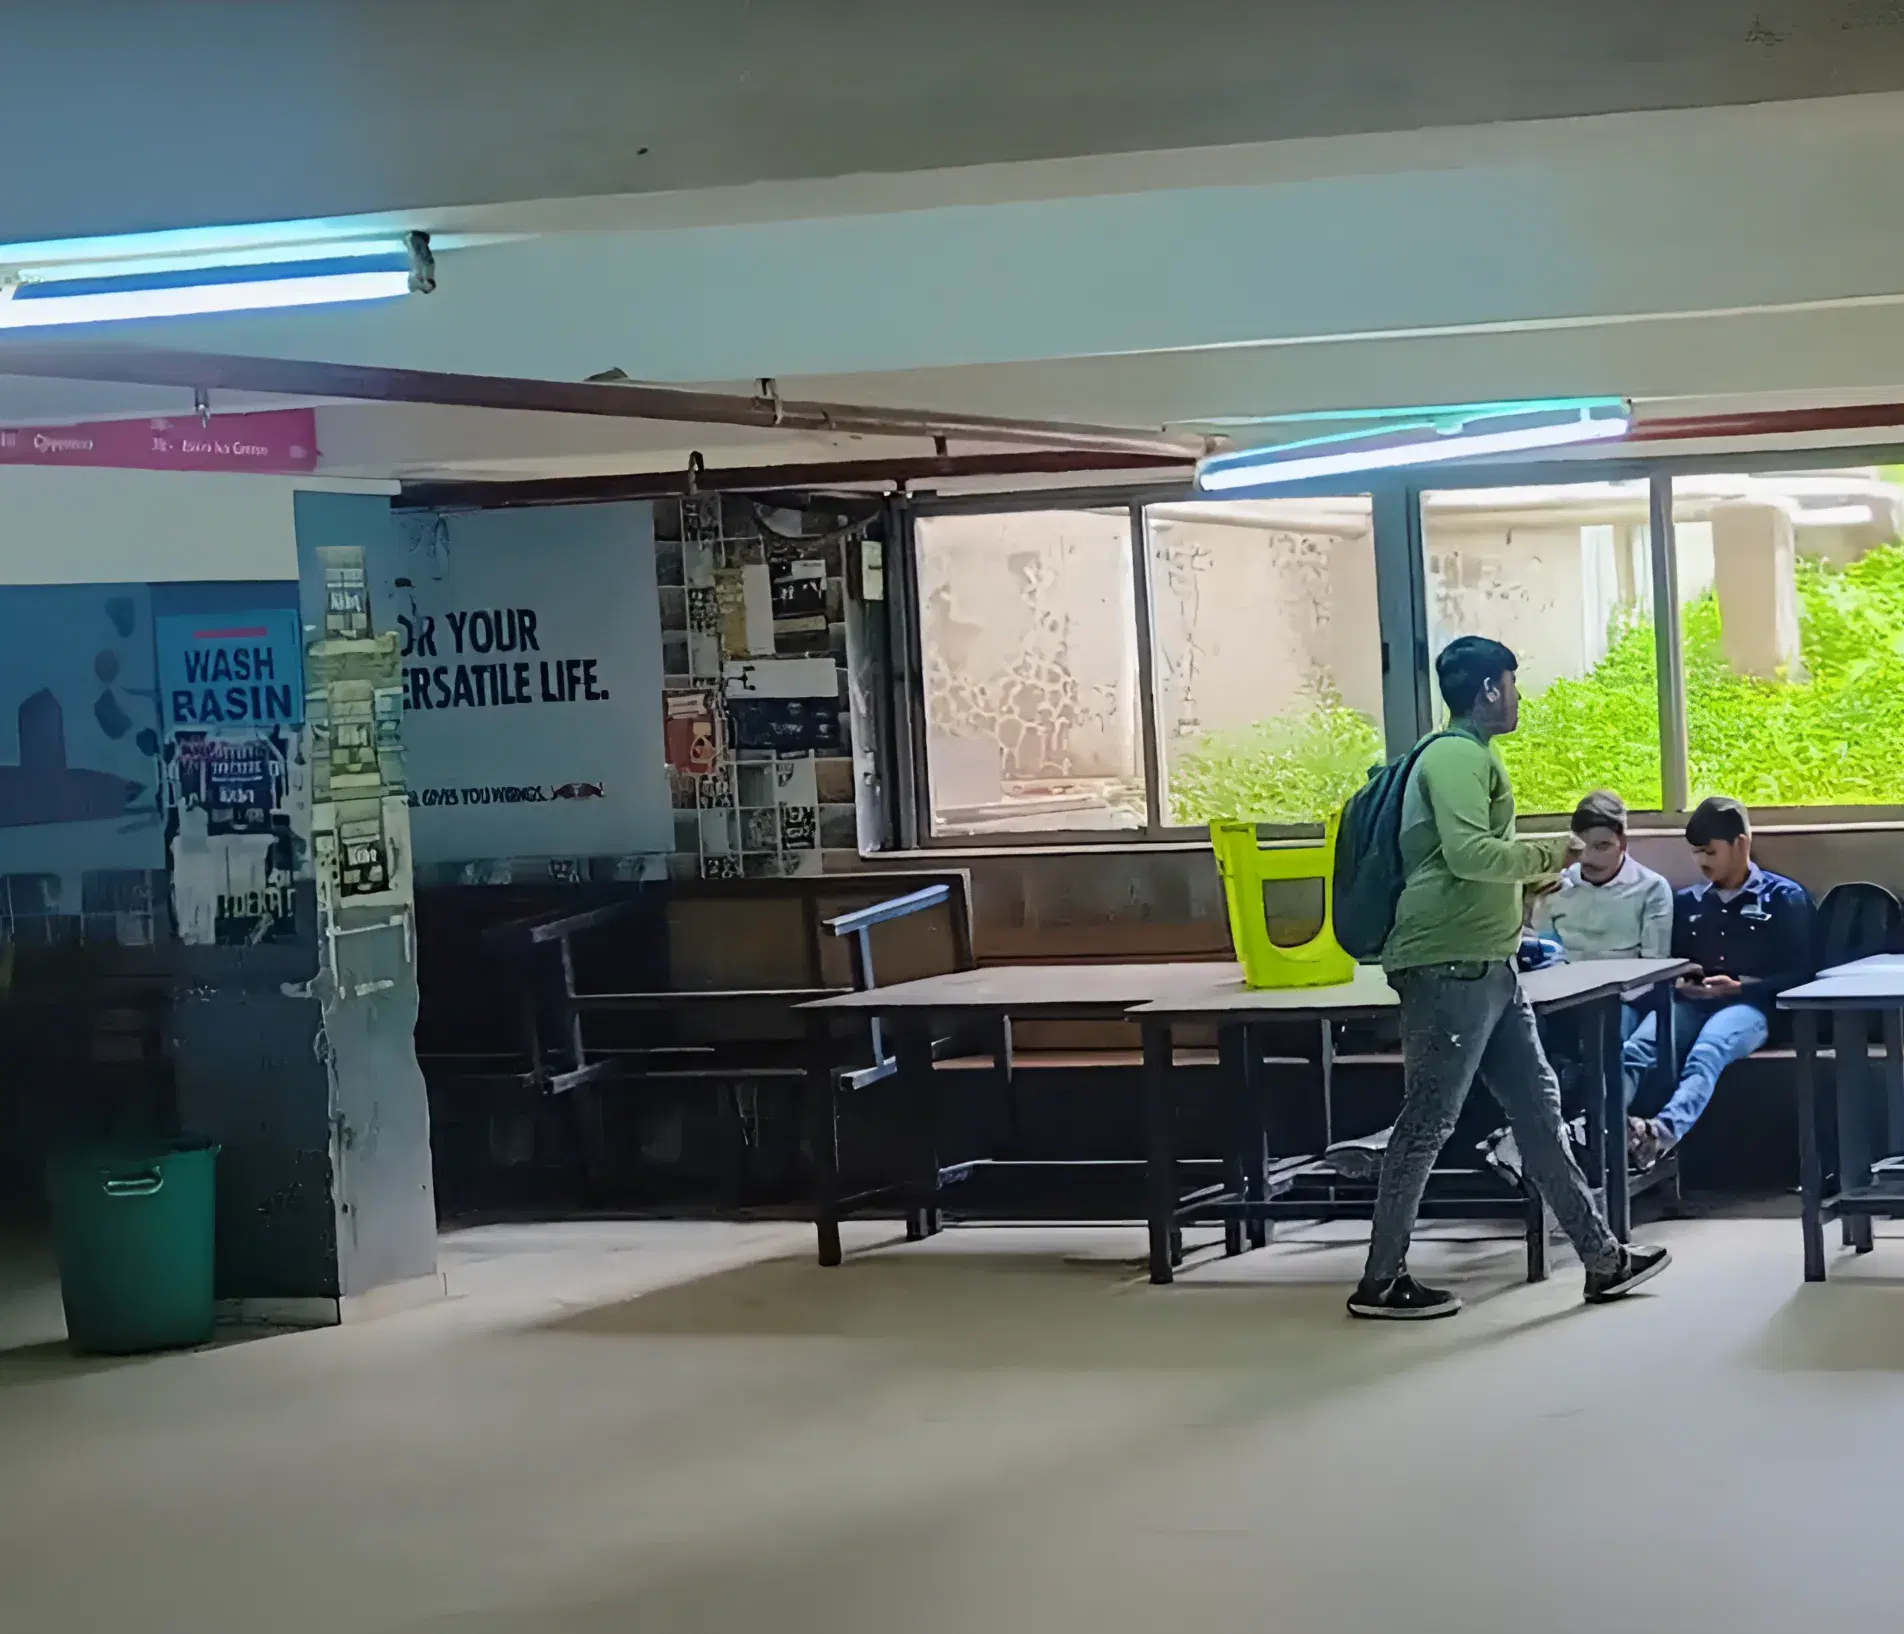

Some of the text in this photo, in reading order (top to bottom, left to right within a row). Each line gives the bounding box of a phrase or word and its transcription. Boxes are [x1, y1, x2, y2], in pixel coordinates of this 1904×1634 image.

[445, 608, 540, 653] YOUR
[184, 647, 274, 683] WASH
[540, 659, 609, 702] LIFE.
[172, 684, 292, 722] BASIN
